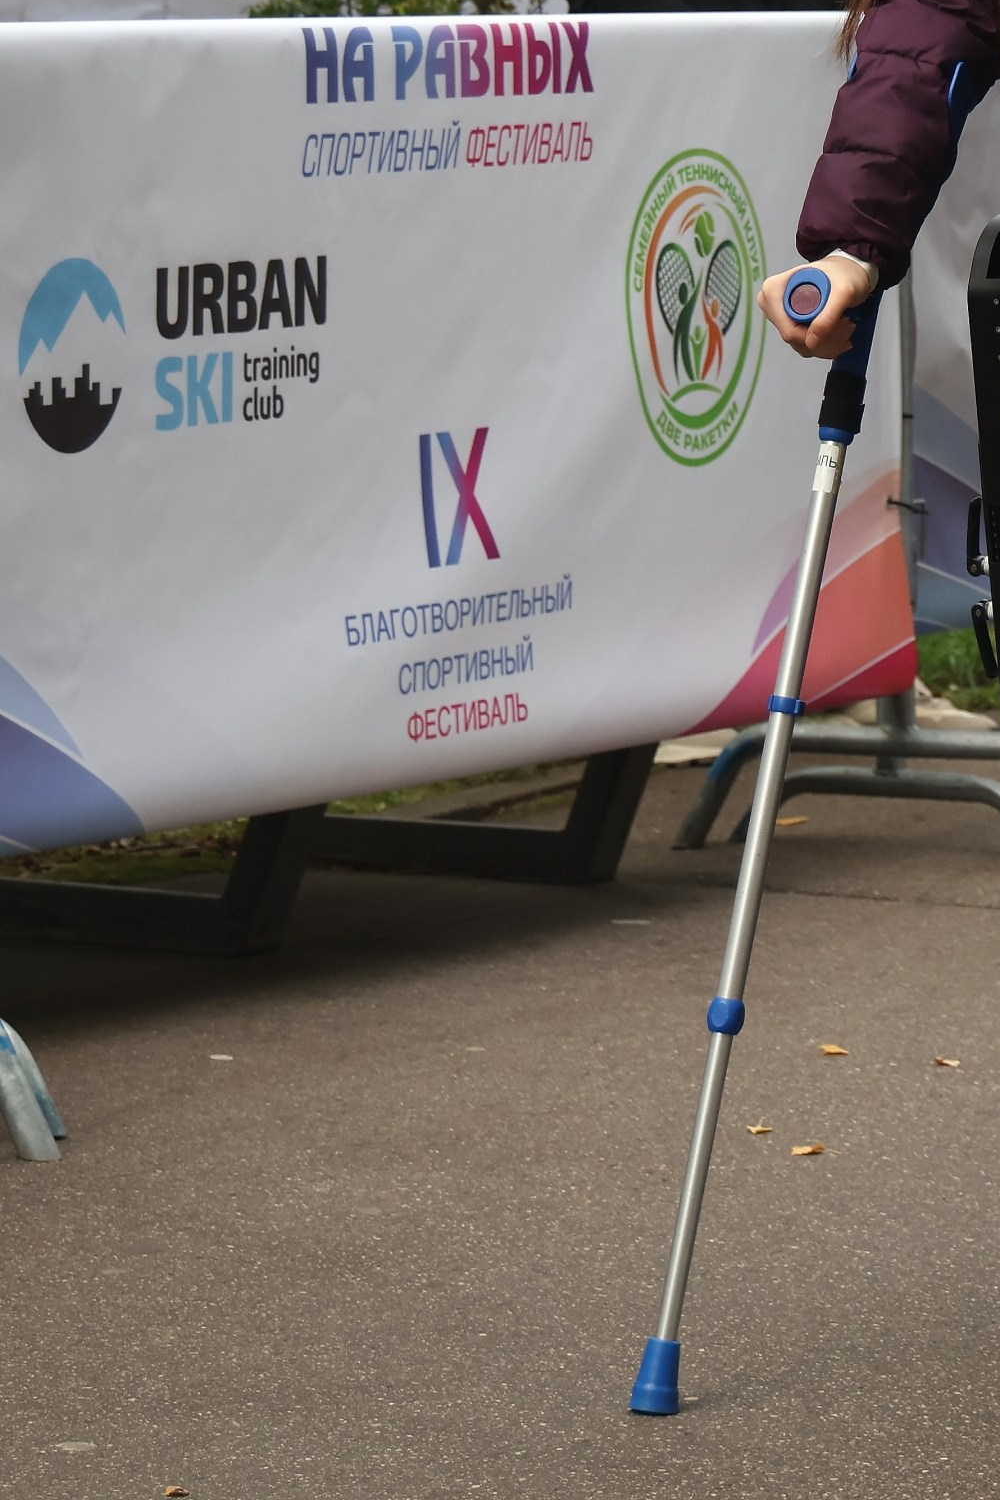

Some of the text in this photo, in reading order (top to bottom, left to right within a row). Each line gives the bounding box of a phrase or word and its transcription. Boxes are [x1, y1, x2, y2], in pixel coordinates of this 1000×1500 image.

[302, 21, 595, 104] НА РАВНЫХ
[301, 121, 594, 178] СПОРТИВНЫЙ ФЕСТИВАЛЬ
[633, 164, 760, 292] СЕМЕЙНЫЙ ТЕННИСНЫЙ КЛУБ
[156, 255, 327, 340] URBAN
[155, 351, 233, 431] SKI
[243, 346, 320, 384] training
[243, 386, 284, 422] club
[656, 401, 739, 452] ДВЕ РАКЕТКИ
[419, 426, 501, 569] IX
[345, 574, 573, 647] БЛАГОТВОРИТЕЛЬНЫЙ
[399, 636, 534, 695] СПОРТИВНЫЙ
[407, 693, 529, 742] ФЕСТИВАЛЬ
